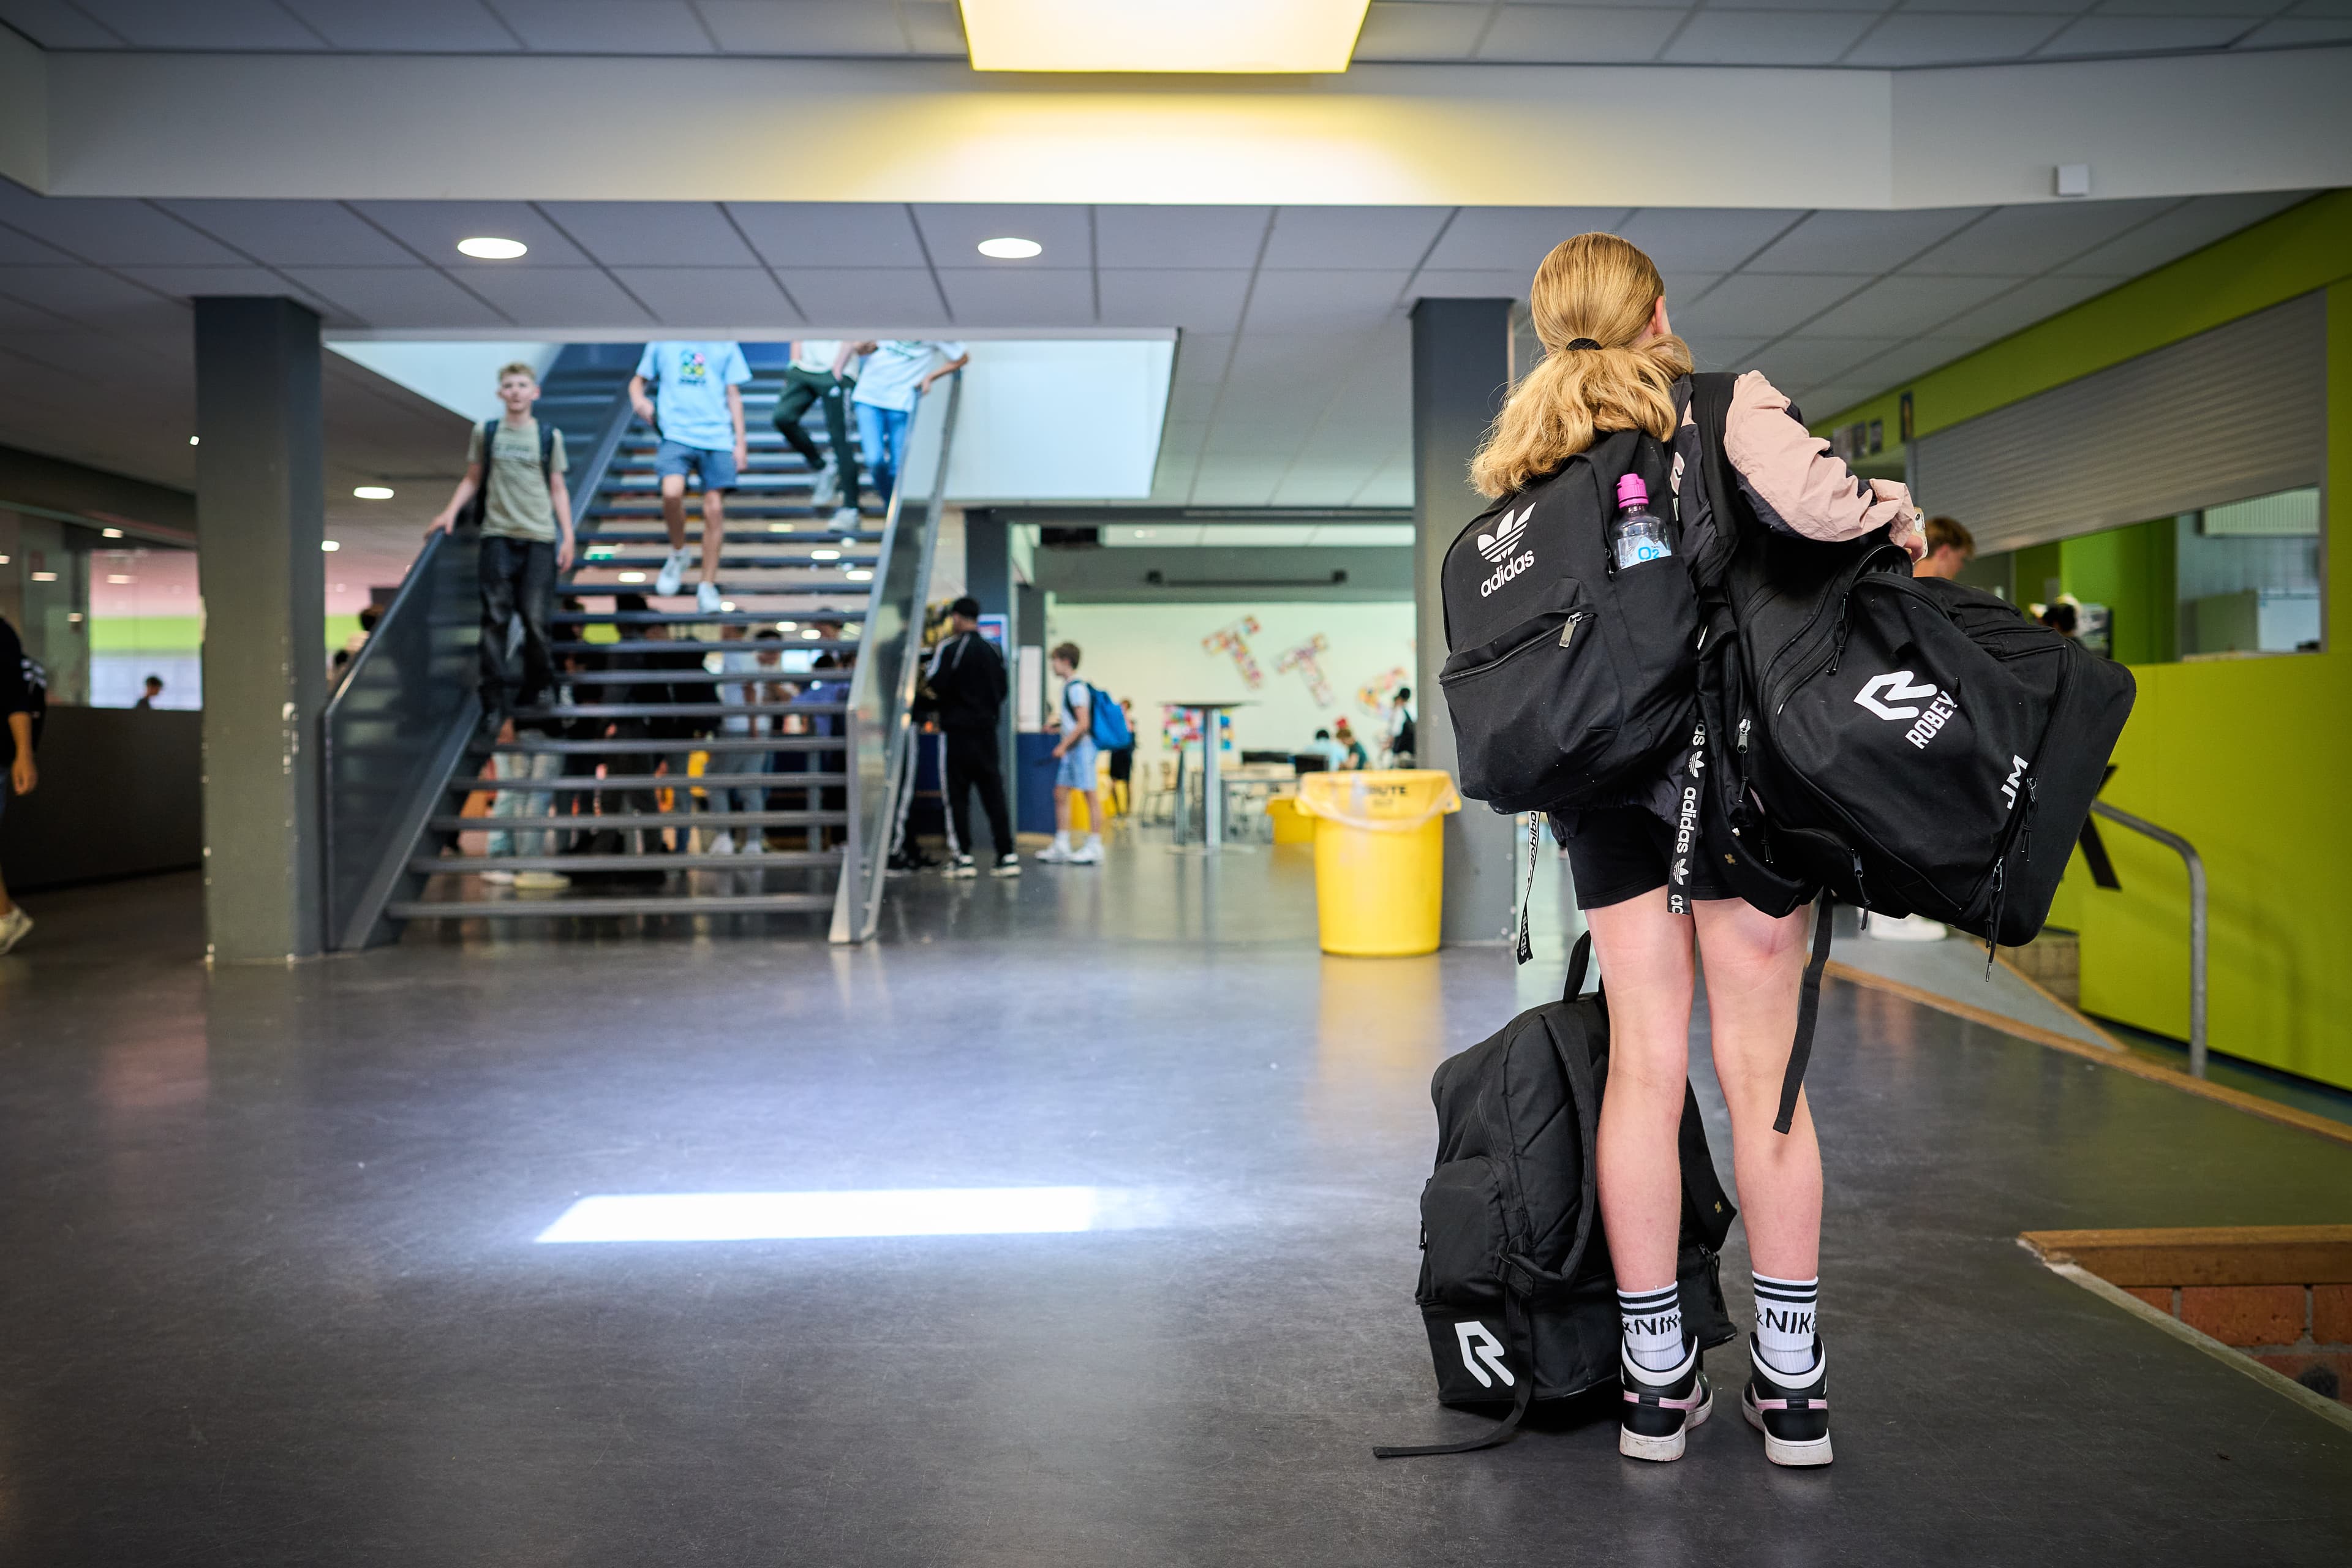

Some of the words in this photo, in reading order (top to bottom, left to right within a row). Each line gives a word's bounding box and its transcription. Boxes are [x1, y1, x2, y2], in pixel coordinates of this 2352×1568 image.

[1480, 550, 1534, 597] adidas
[1905, 690, 1958, 749] ROBEY
[2000, 754, 2029, 810] JM
[1676, 786, 1697, 853] adidas
[1634, 1314, 1681, 1335] NIK
[1766, 1307, 1816, 1334] NIK
